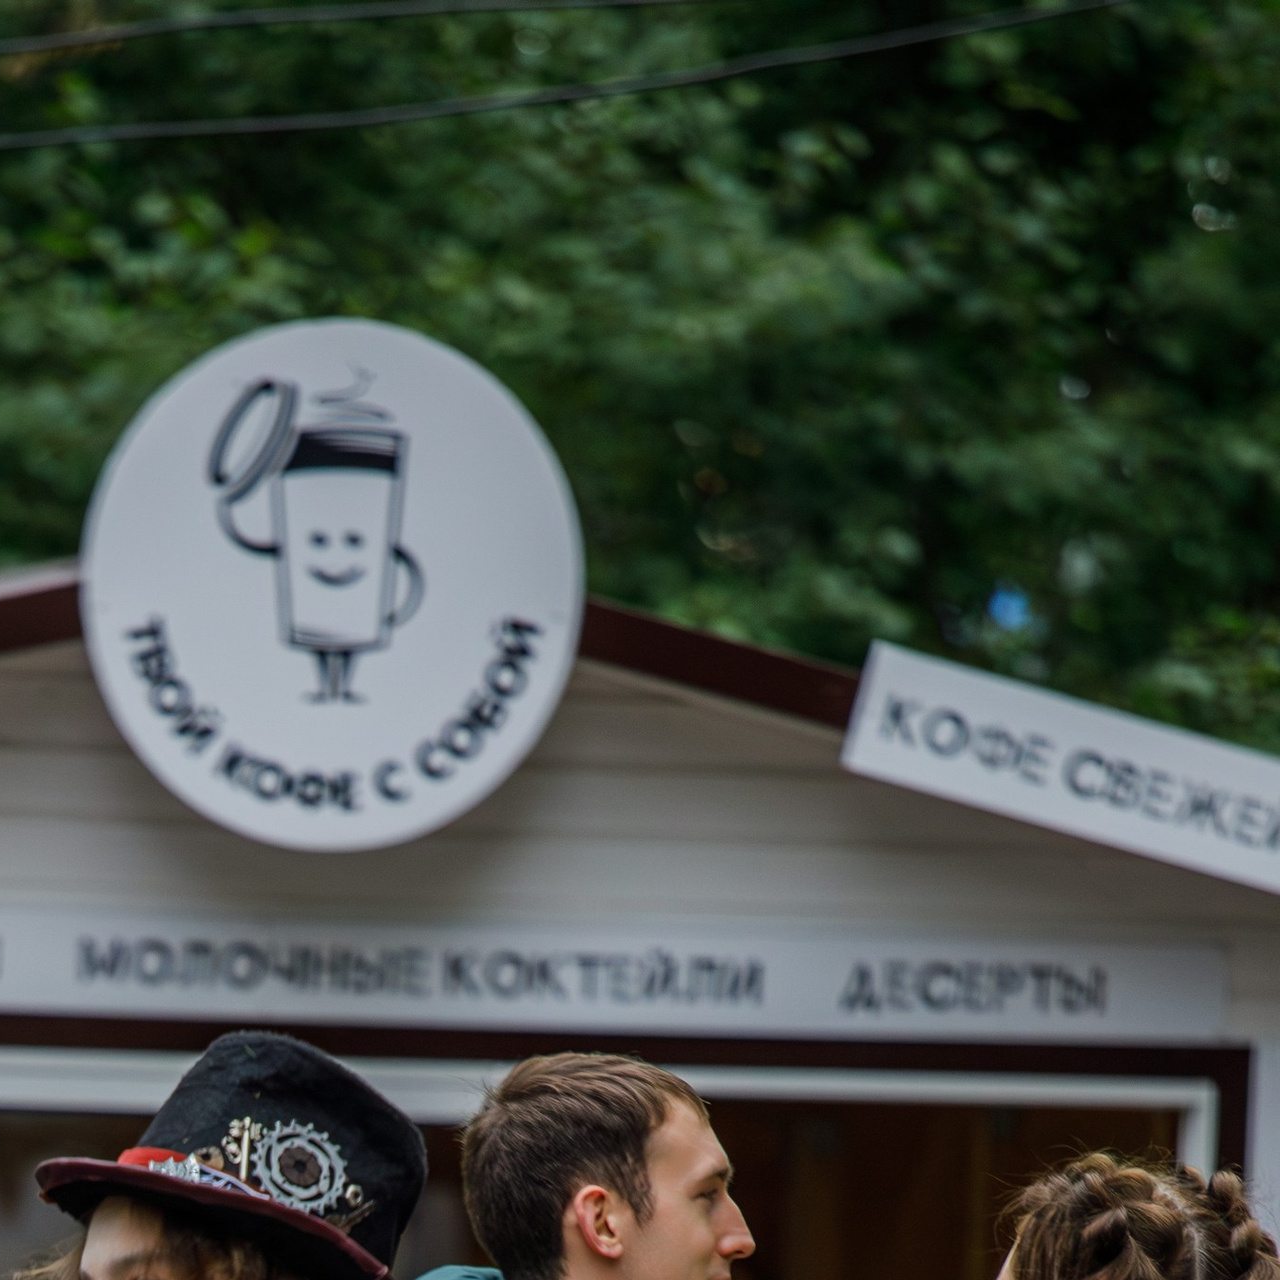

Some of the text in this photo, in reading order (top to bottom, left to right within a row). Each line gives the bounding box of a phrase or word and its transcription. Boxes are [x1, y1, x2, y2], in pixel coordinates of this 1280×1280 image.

[126, 613, 544, 812] ТВОЙ КОФЕ С СОБОЙ
[880, 695, 1054, 786] КОФЕ
[75, 937, 430, 998] МОЛОЧНЫЕ
[436, 945, 768, 1007] КОКТЕЙЛИ
[837, 958, 1110, 1017] ДЕСЕРТЫ
